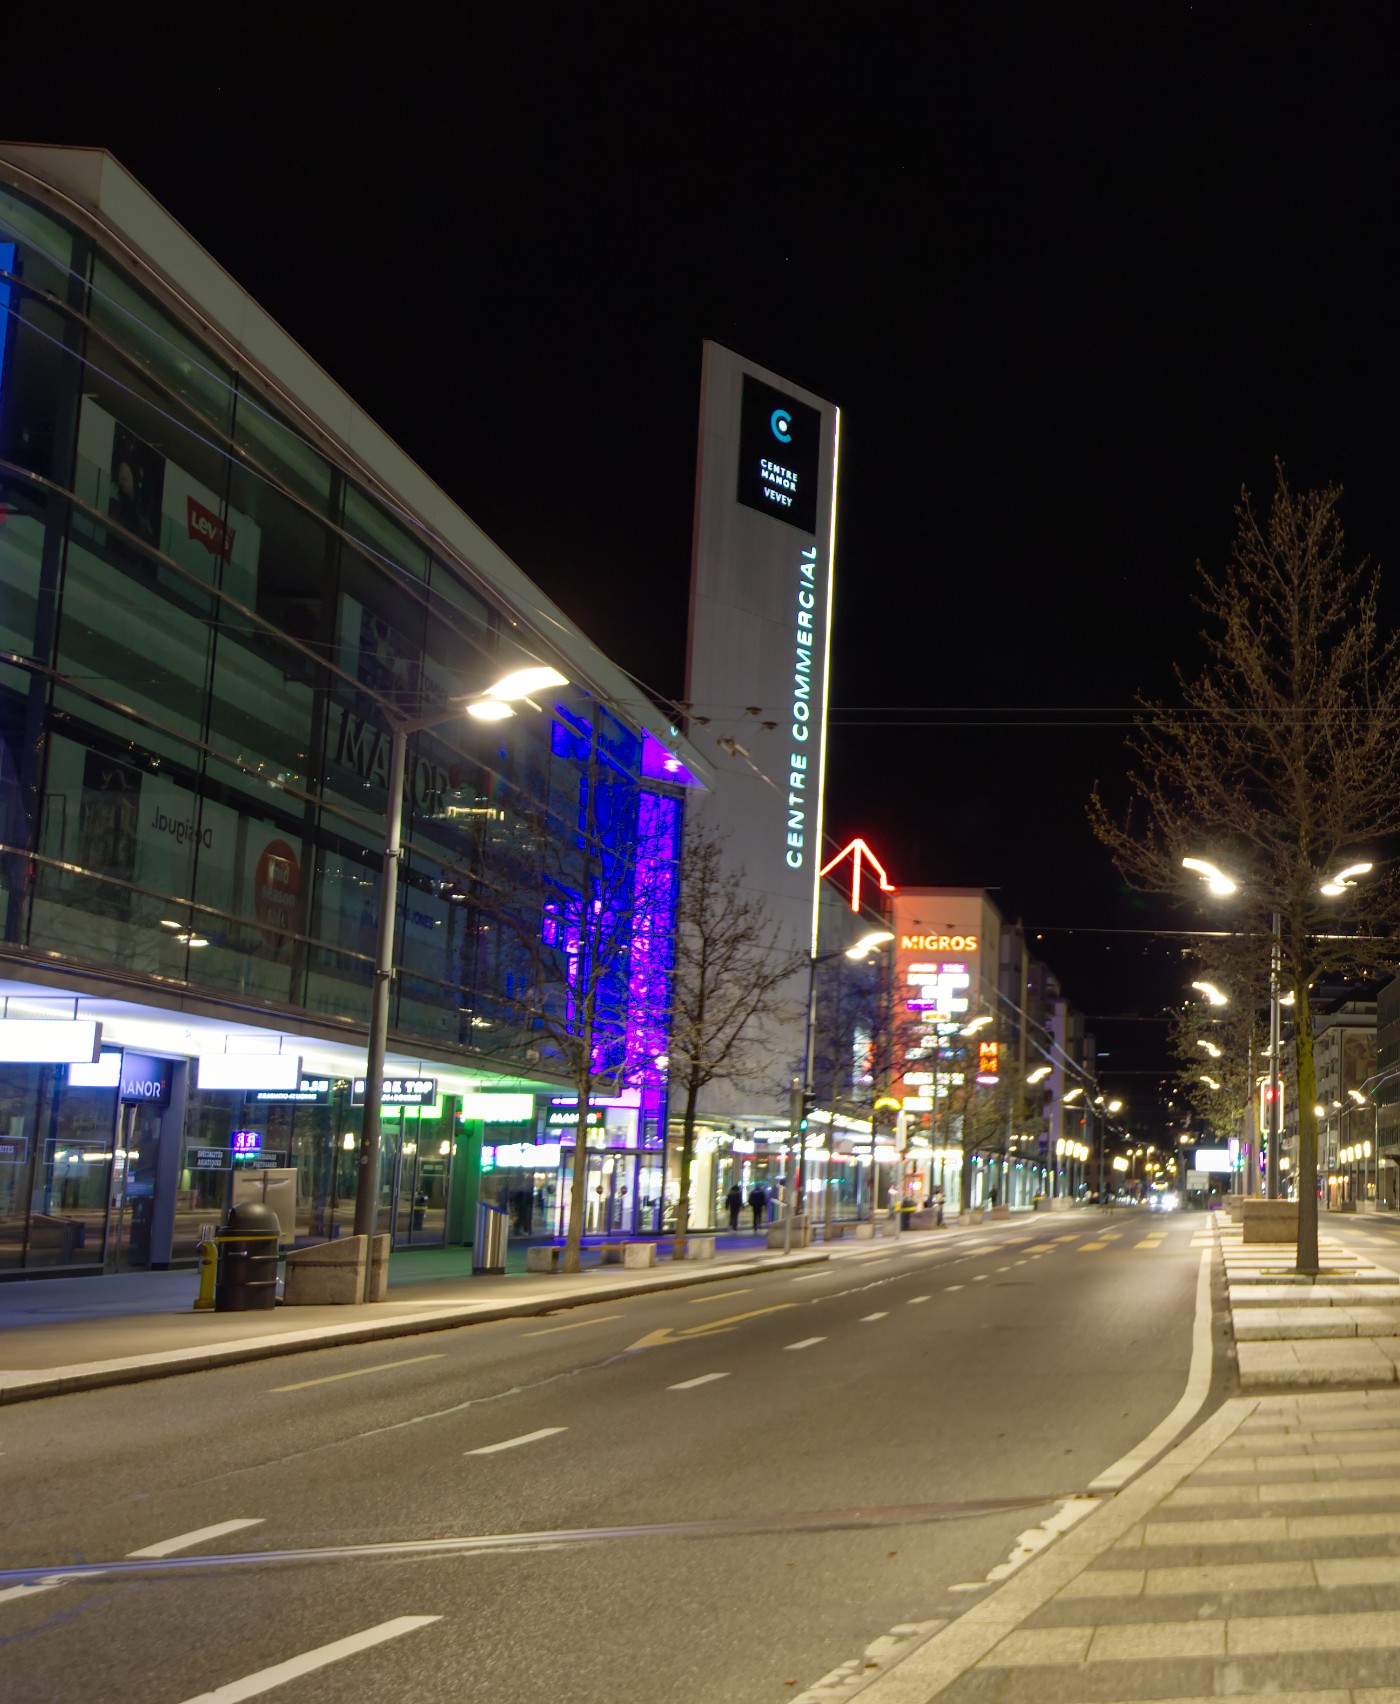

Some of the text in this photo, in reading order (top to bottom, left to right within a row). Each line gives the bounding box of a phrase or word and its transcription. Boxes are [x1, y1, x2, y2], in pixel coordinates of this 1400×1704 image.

[760, 458, 798, 482] CENTRE
[761, 468, 797, 492] MANOR
[763, 486, 793, 507] VEVEY
[191, 510, 230, 551] Levs
[786, 545, 817, 869] CENTRE COMMERCIAL
[900, 935, 978, 951] MIGROS
[550, 1112, 597, 1124] MANR
